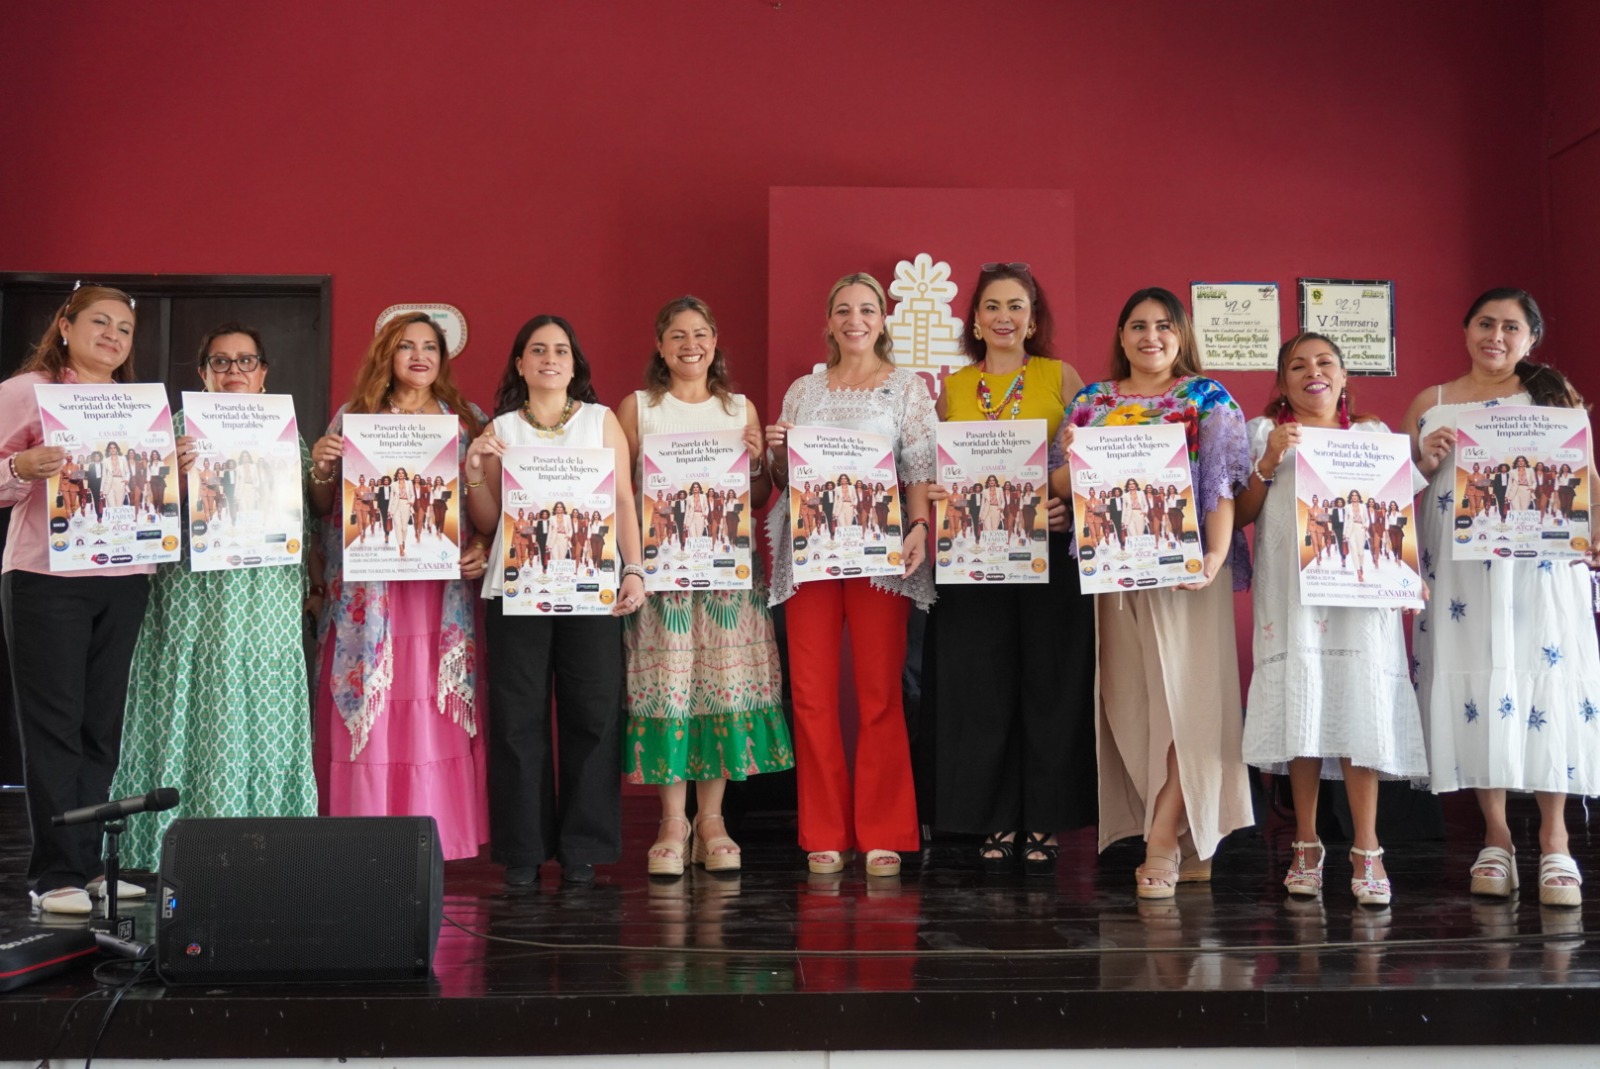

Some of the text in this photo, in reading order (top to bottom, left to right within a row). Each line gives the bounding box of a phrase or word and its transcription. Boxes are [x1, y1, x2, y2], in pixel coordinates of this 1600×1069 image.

[1317, 315, 1378, 327] V Aniversario
[118, 403, 151, 411] Mujeres
[222, 421, 263, 430] Imparables
[1328, 441, 1358, 449] Pasarela
[1314, 449, 1351, 458] Sororidad
[1364, 452, 1394, 461] Mujeres
[1332, 460, 1375, 468] Imparables
[165, 887, 174, 918] ALTO
